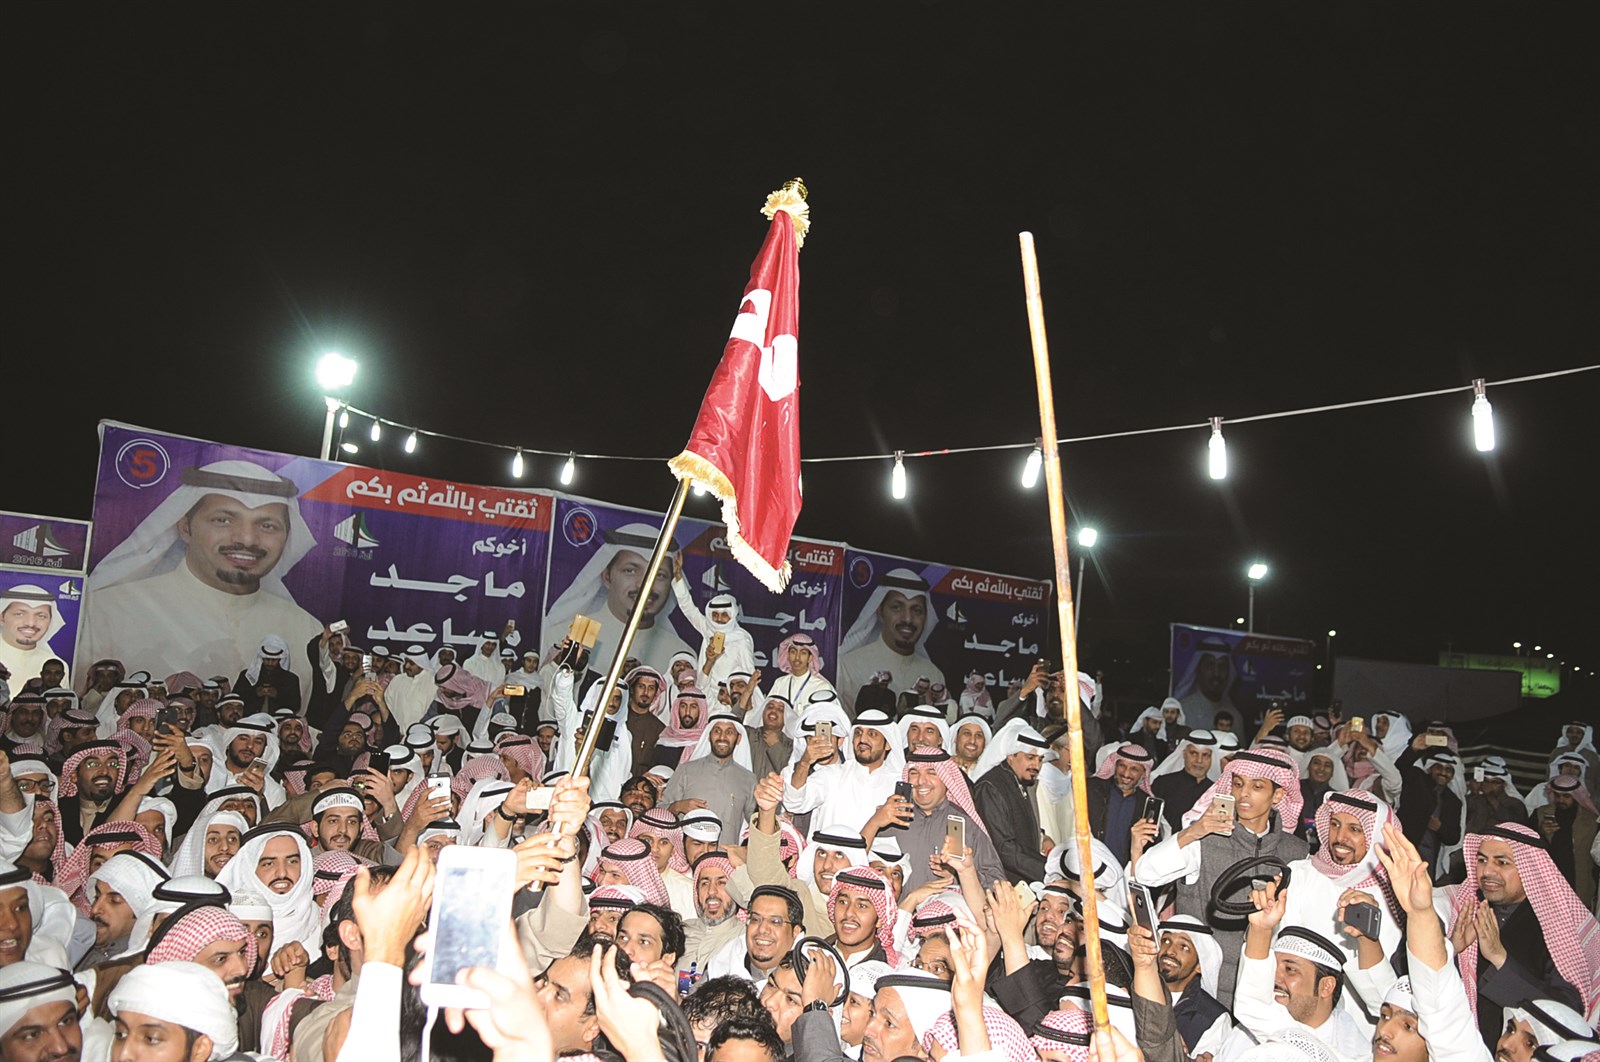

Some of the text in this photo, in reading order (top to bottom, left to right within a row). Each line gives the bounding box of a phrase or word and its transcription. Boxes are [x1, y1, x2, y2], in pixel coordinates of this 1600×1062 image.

[128, 449, 157, 479] 5
[346, 476, 392, 504] بكم
[397, 481, 429, 505] ثم
[478, 498, 538, 519] ثقتي
[472, 536, 526, 557] أخوكم
[12, 554, 43, 565] 2016
[795, 549, 835, 566] ثقتي
[369, 563, 526, 602] ماجد
[791, 581, 827, 597] أخوكم
[951, 575, 973, 593] بكم
[975, 577, 990, 594] ثم
[1014, 586, 1043, 600] ثقتي
[964, 633, 1038, 657] ماجد
